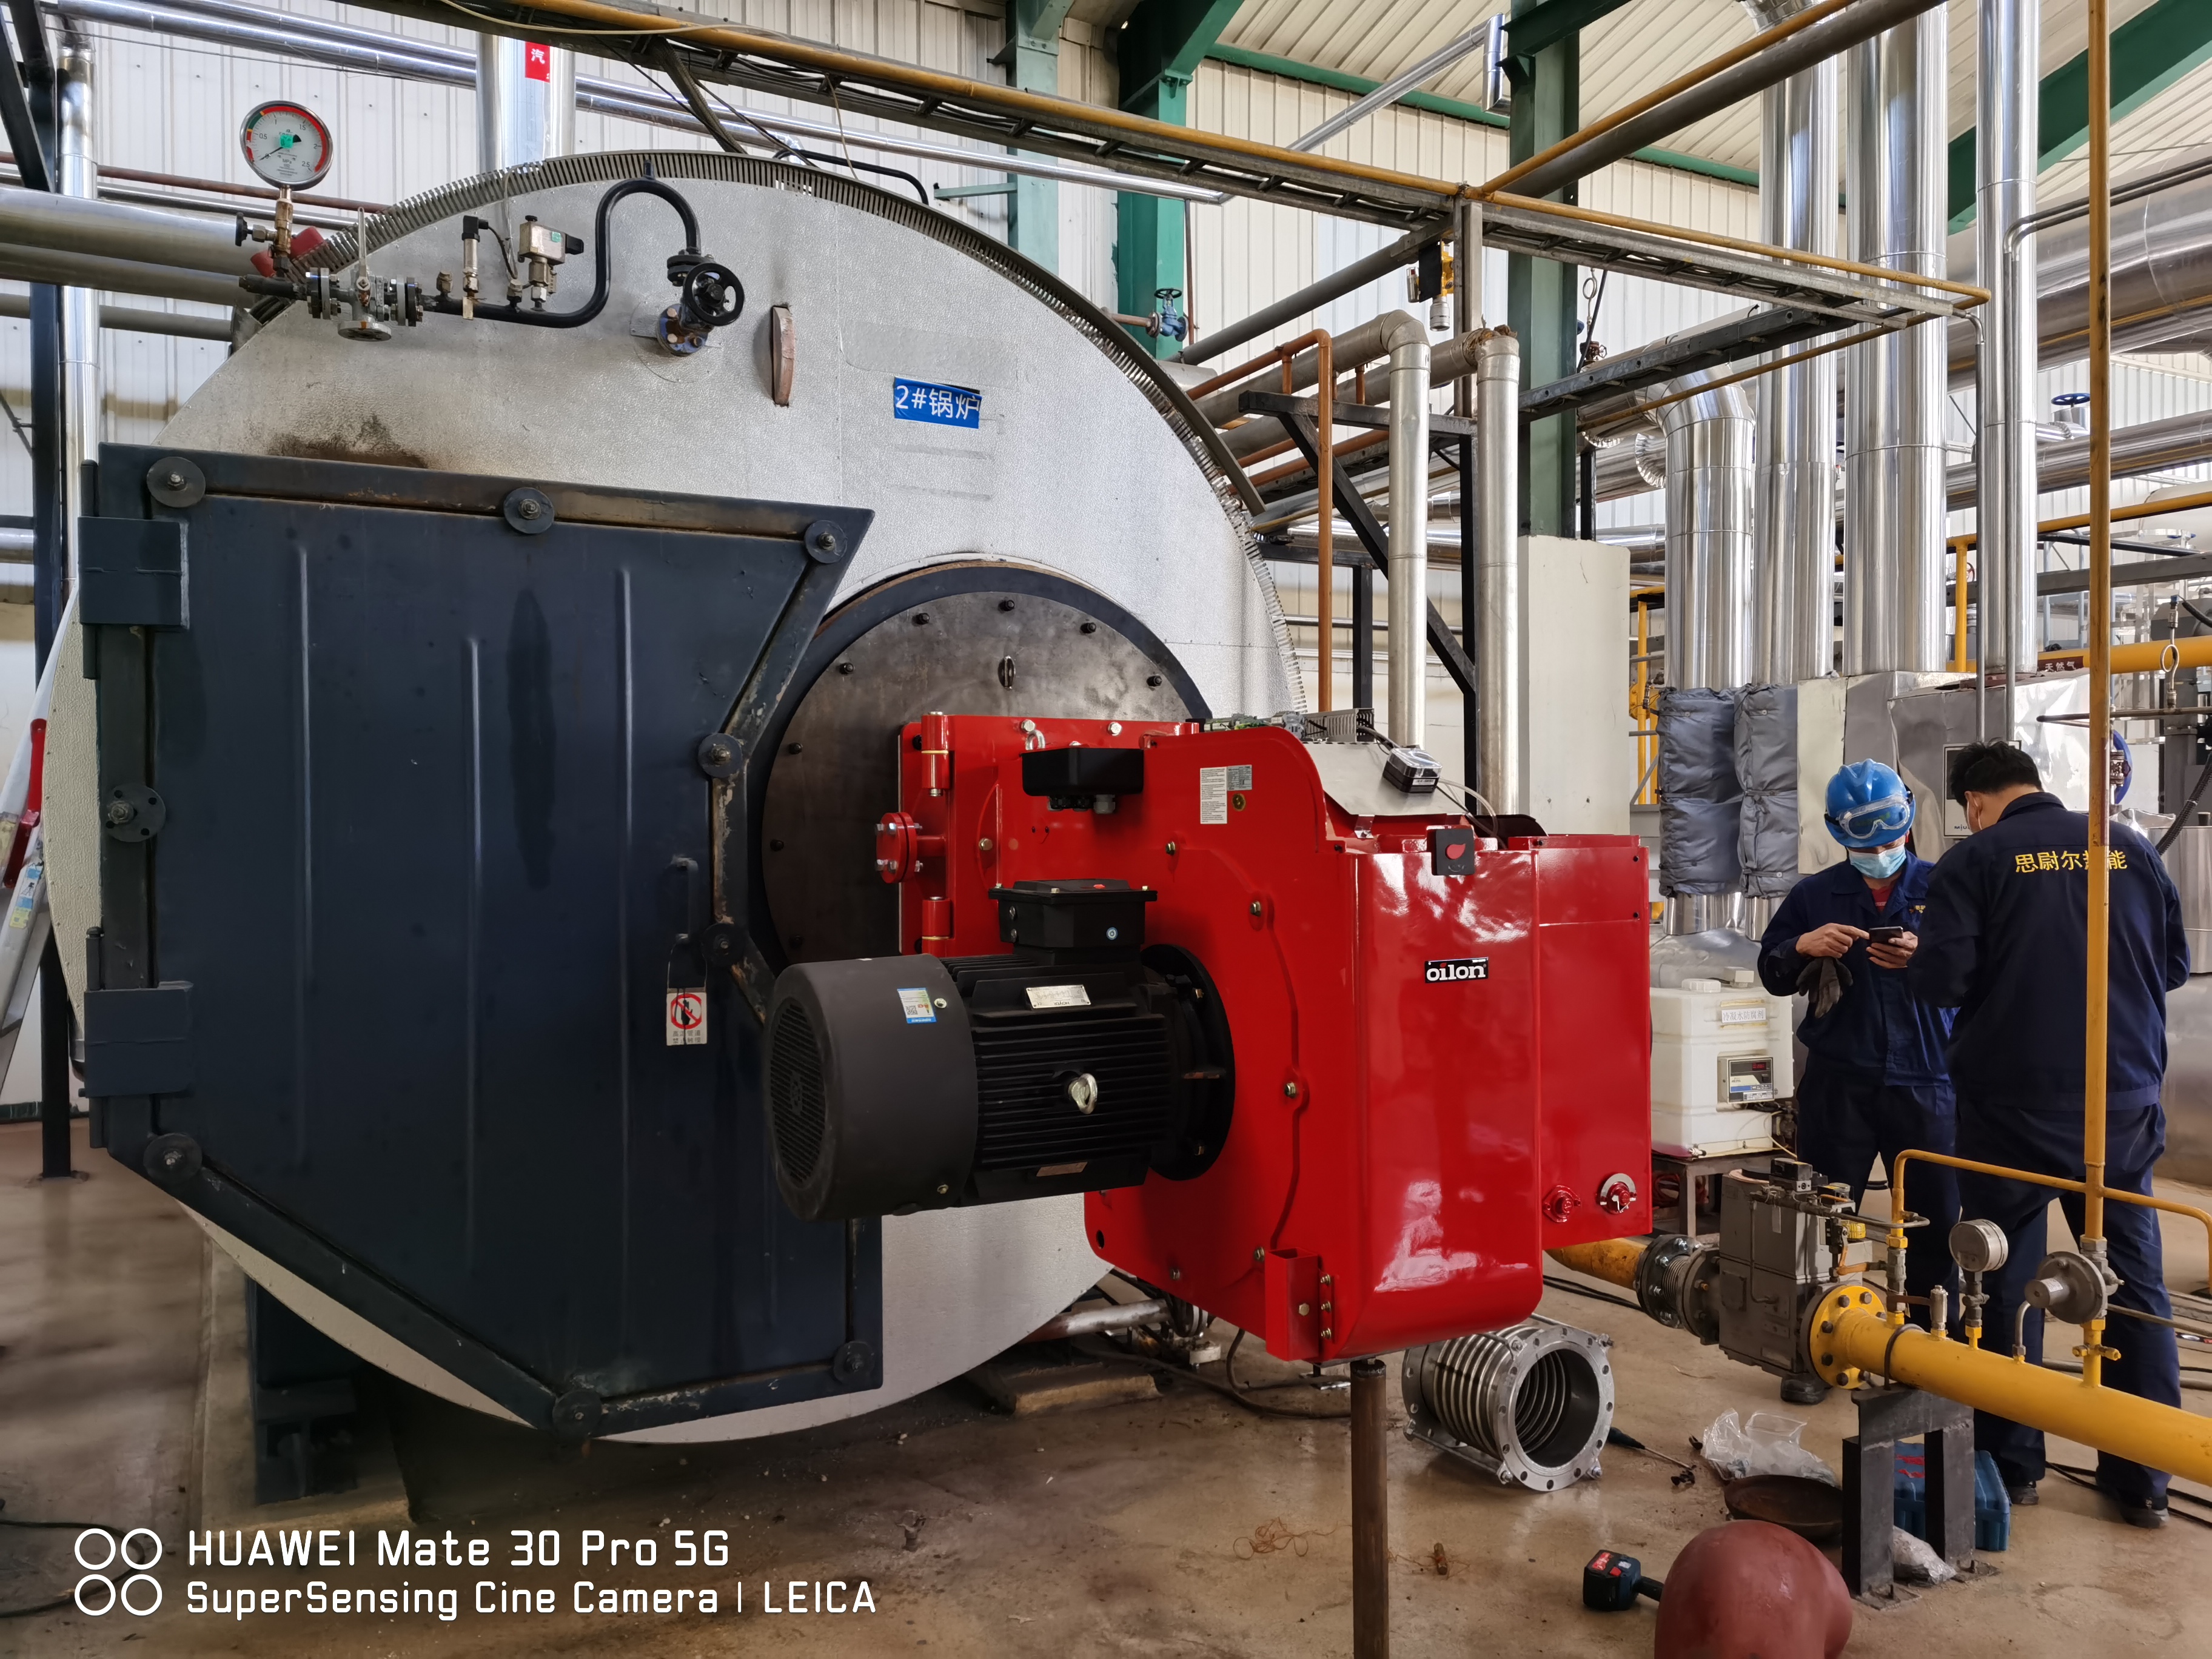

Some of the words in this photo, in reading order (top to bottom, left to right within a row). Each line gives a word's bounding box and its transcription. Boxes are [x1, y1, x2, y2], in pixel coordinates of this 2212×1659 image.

[531, 48, 545, 64] 汽
[896, 385, 980, 420] 2#锅炉
[2045, 661, 2077, 672] 天然气
[2015, 850, 2128, 873] 思尉尔能
[1426, 963, 1486, 981] oilon
[1723, 1010, 1765, 1021] 冷凝水防腐剂
